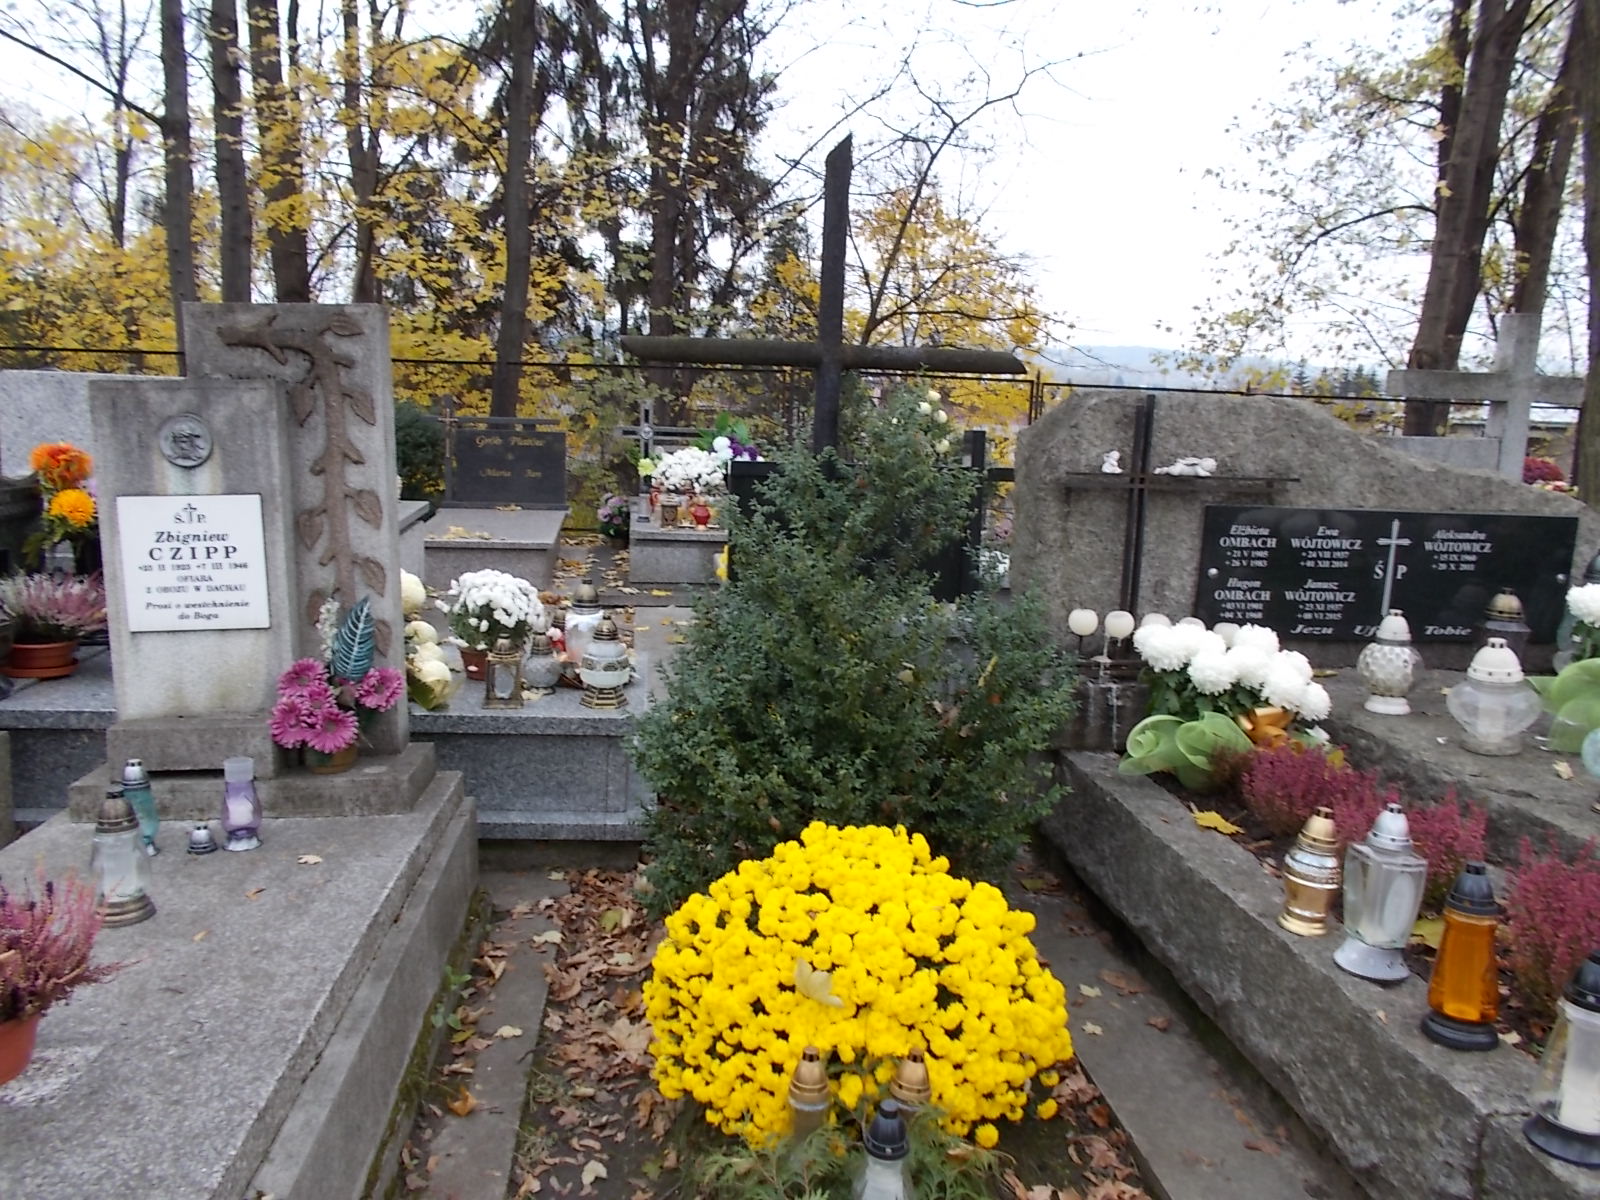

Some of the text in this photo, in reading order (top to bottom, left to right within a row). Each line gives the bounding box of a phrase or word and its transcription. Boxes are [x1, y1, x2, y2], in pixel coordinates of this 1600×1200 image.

[1230, 524, 1270, 537] Elżbieta
[1317, 526, 1340, 537] Ewa
[1432, 529, 1487, 541] Aleksandra
[154, 531, 228, 545] Zbigniew
[1219, 536, 1277, 548] OMBACH
[1290, 535, 1363, 550] WÓJTOWICZ
[1424, 540, 1493, 553] WÓJTOWICZ
[149, 545, 238, 561] CZIPP
[1396, 565, 1408, 579] P
[176, 575, 213, 583] OFIARA
[1227, 577, 1262, 590] Hugon
[1303, 578, 1340, 590] Janusz
[156, 586, 190, 594] OBOZU
[206, 584, 246, 592] DACHAU
[1284, 588, 1357, 602] WÓJTOWICZ
[1214, 590, 1271, 601] OMBACH
[178, 611, 219, 621] do Boga
[1290, 624, 1334, 635] Jezu
[1424, 625, 1472, 636] Tobie
